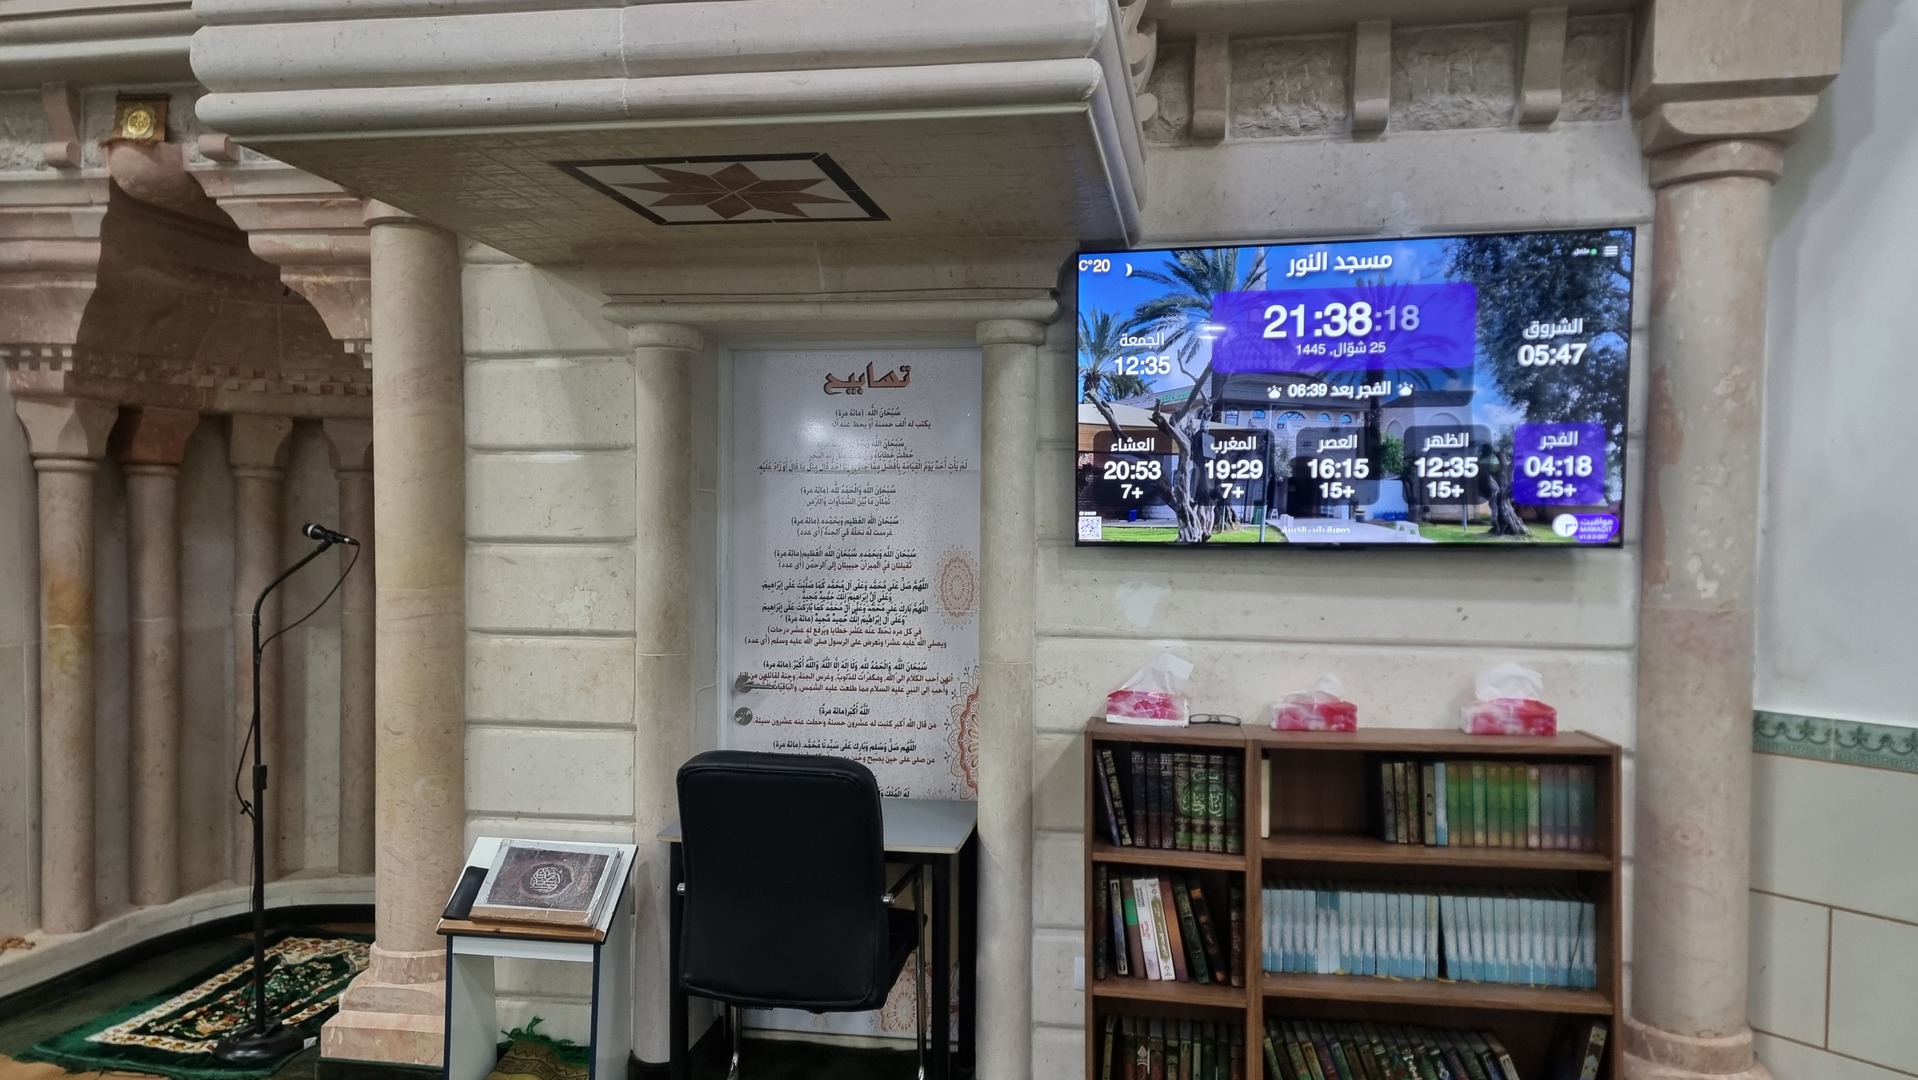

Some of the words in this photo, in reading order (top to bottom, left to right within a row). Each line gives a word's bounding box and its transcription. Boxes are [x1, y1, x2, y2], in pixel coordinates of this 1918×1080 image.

[1286, 251, 1328, 277] النور
[1334, 252, 1393, 274] مسجد
[1263, 302, 1419, 338] 21:38:18
[1523, 318, 1584, 340] الشروق
[1120, 333, 1165, 347] الجمعة
[1370, 342, 1386, 353] 25
[1296, 345, 1326, 356] 1445
[1518, 343, 1588, 366] 05:47
[1114, 356, 1171, 376] 12:35
[1288, 383, 1328, 398] 06:39
[1330, 385, 1355, 399] بعد
[1356, 382, 1391, 400] الفجر
[1111, 438, 1155, 453] العشاء
[1211, 436, 1257, 453] المغرب
[1318, 435, 1358, 453] العصر
[1423, 433, 1469, 451] الظهر
[1540, 431, 1578, 450] الفجر
[1103, 460, 1162, 480] 20:53
[1205, 459, 1263, 480] 19:29
[1308, 458, 1369, 479] 16:15
[1414, 457, 1479, 478] 12:35
[1523, 455, 1592, 477] 04:18
